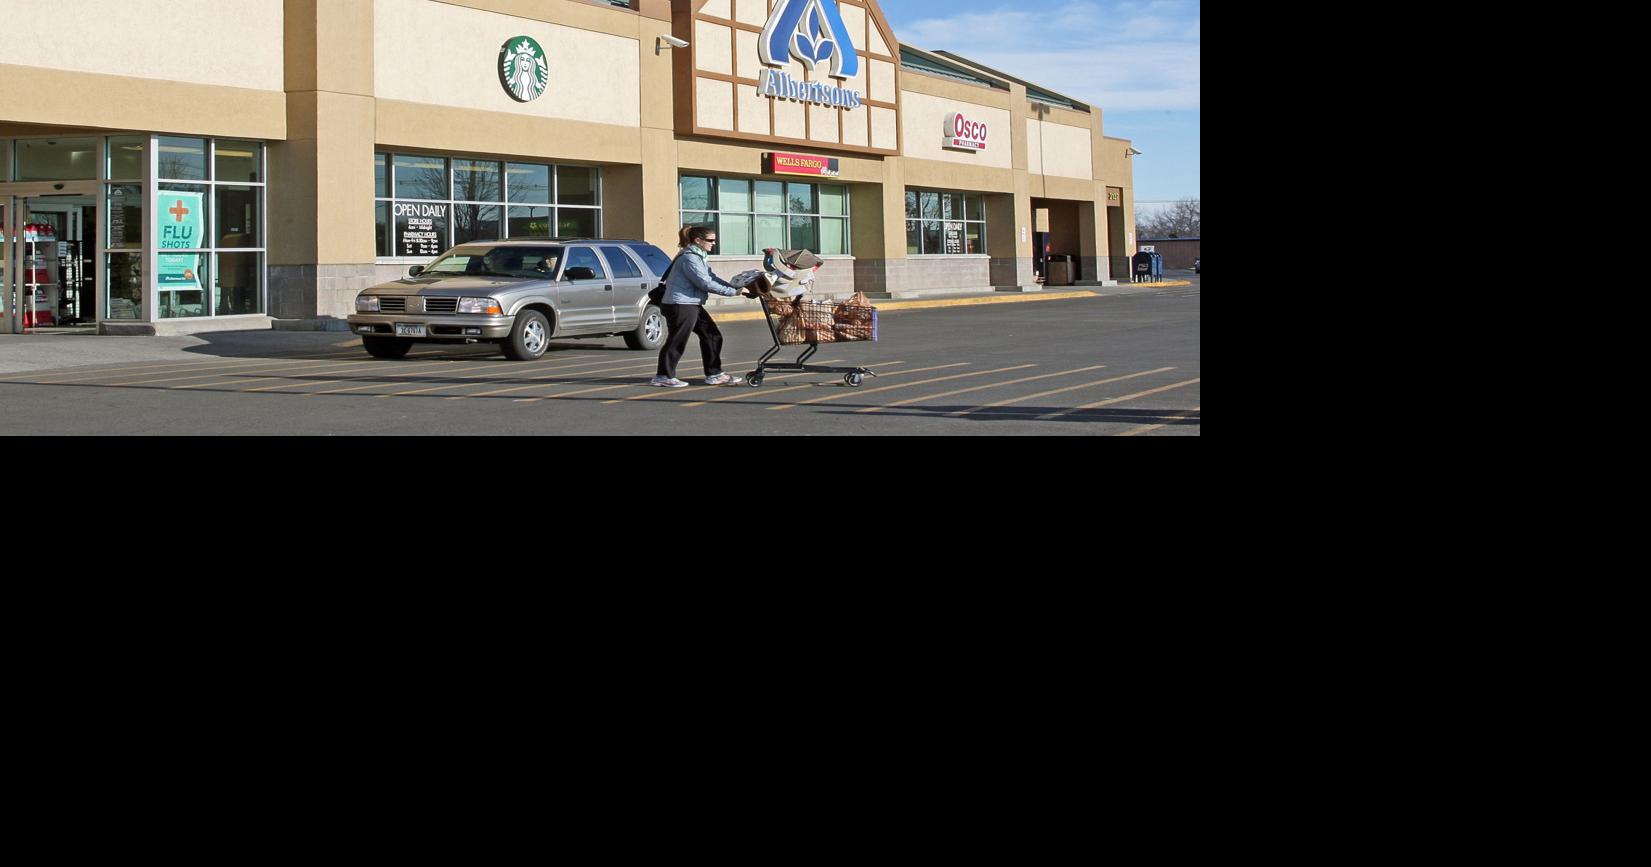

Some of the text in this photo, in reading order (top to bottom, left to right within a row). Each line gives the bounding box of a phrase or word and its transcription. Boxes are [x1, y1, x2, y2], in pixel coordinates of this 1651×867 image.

[764, 69, 862, 109] Albertsons
[776, 157, 822, 169] WELLS FARGO
[394, 203, 446, 217] OPEN DAILY
[163, 225, 192, 239] FLU
[161, 240, 190, 249] SHOTS
